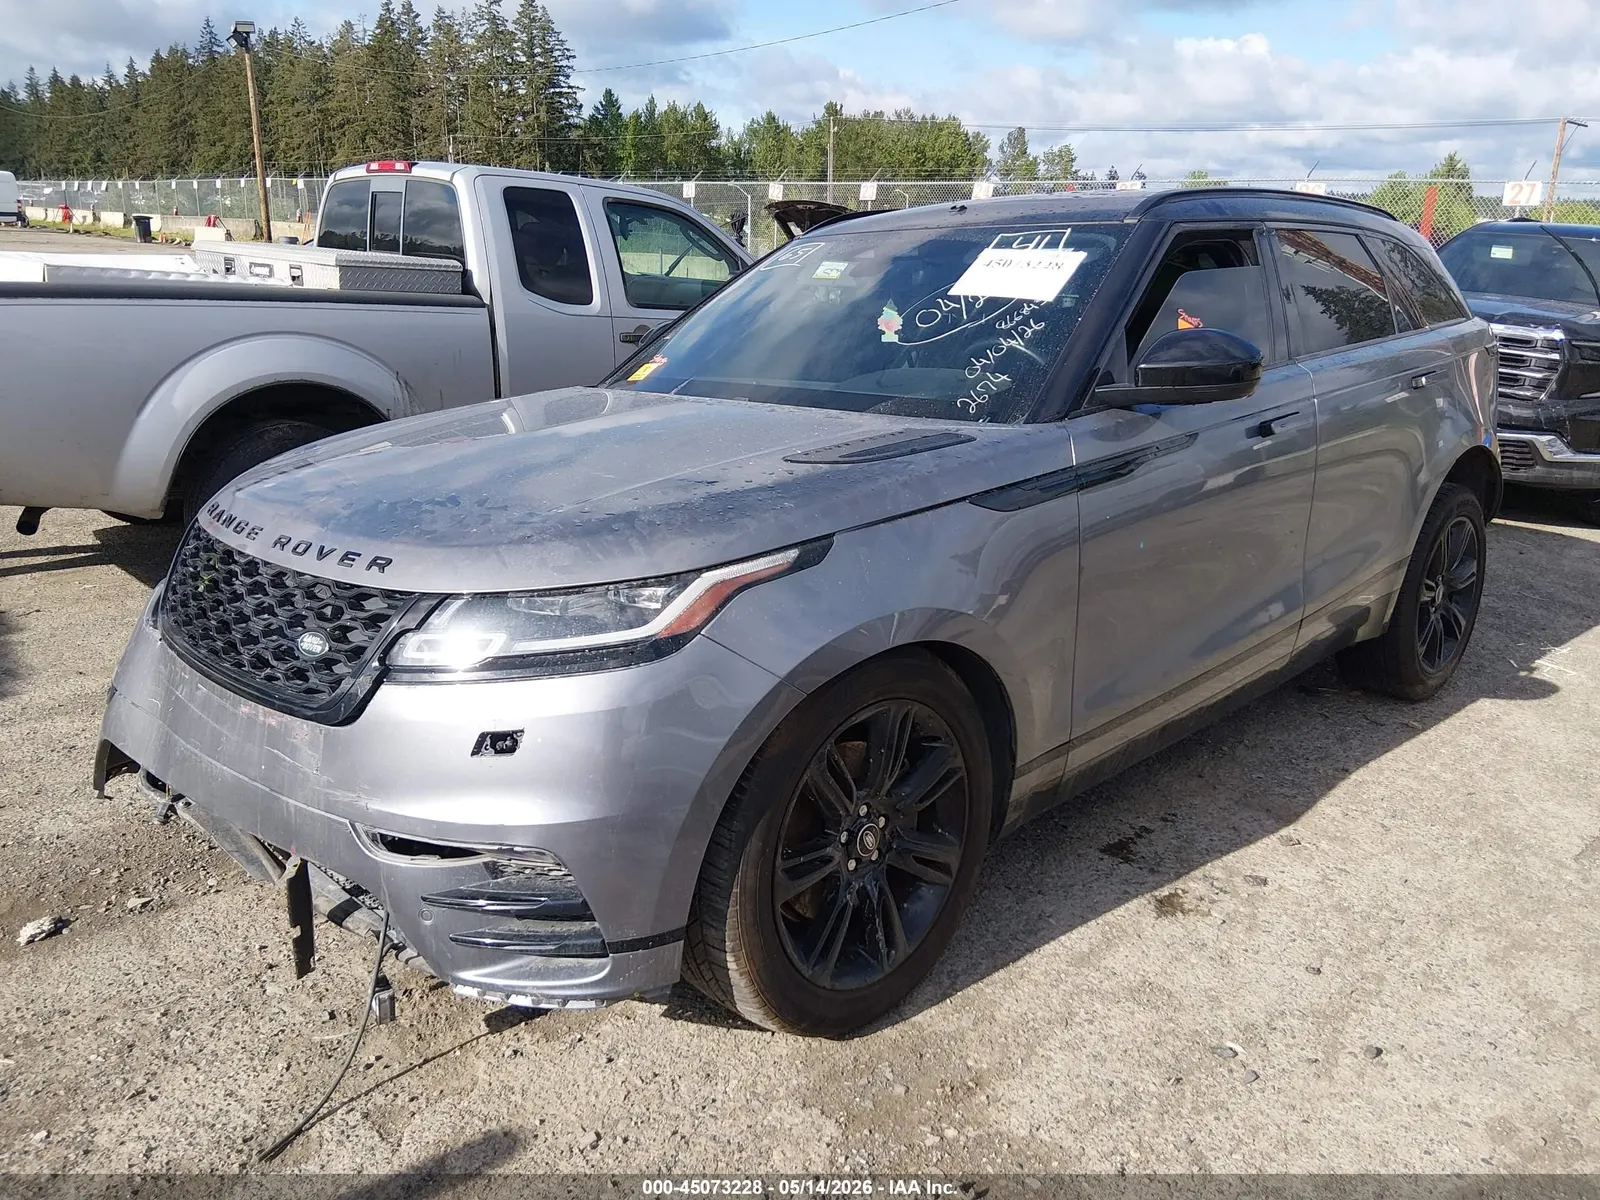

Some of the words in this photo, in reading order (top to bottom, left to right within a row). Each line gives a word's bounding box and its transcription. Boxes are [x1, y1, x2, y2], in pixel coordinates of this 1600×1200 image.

[770, 184, 782, 199] 22
[1510, 183, 1536, 205] 27
[916, 293, 990, 327] 04/2
[206, 501, 264, 542] RANGE
[271, 534, 394, 574] ROVER
